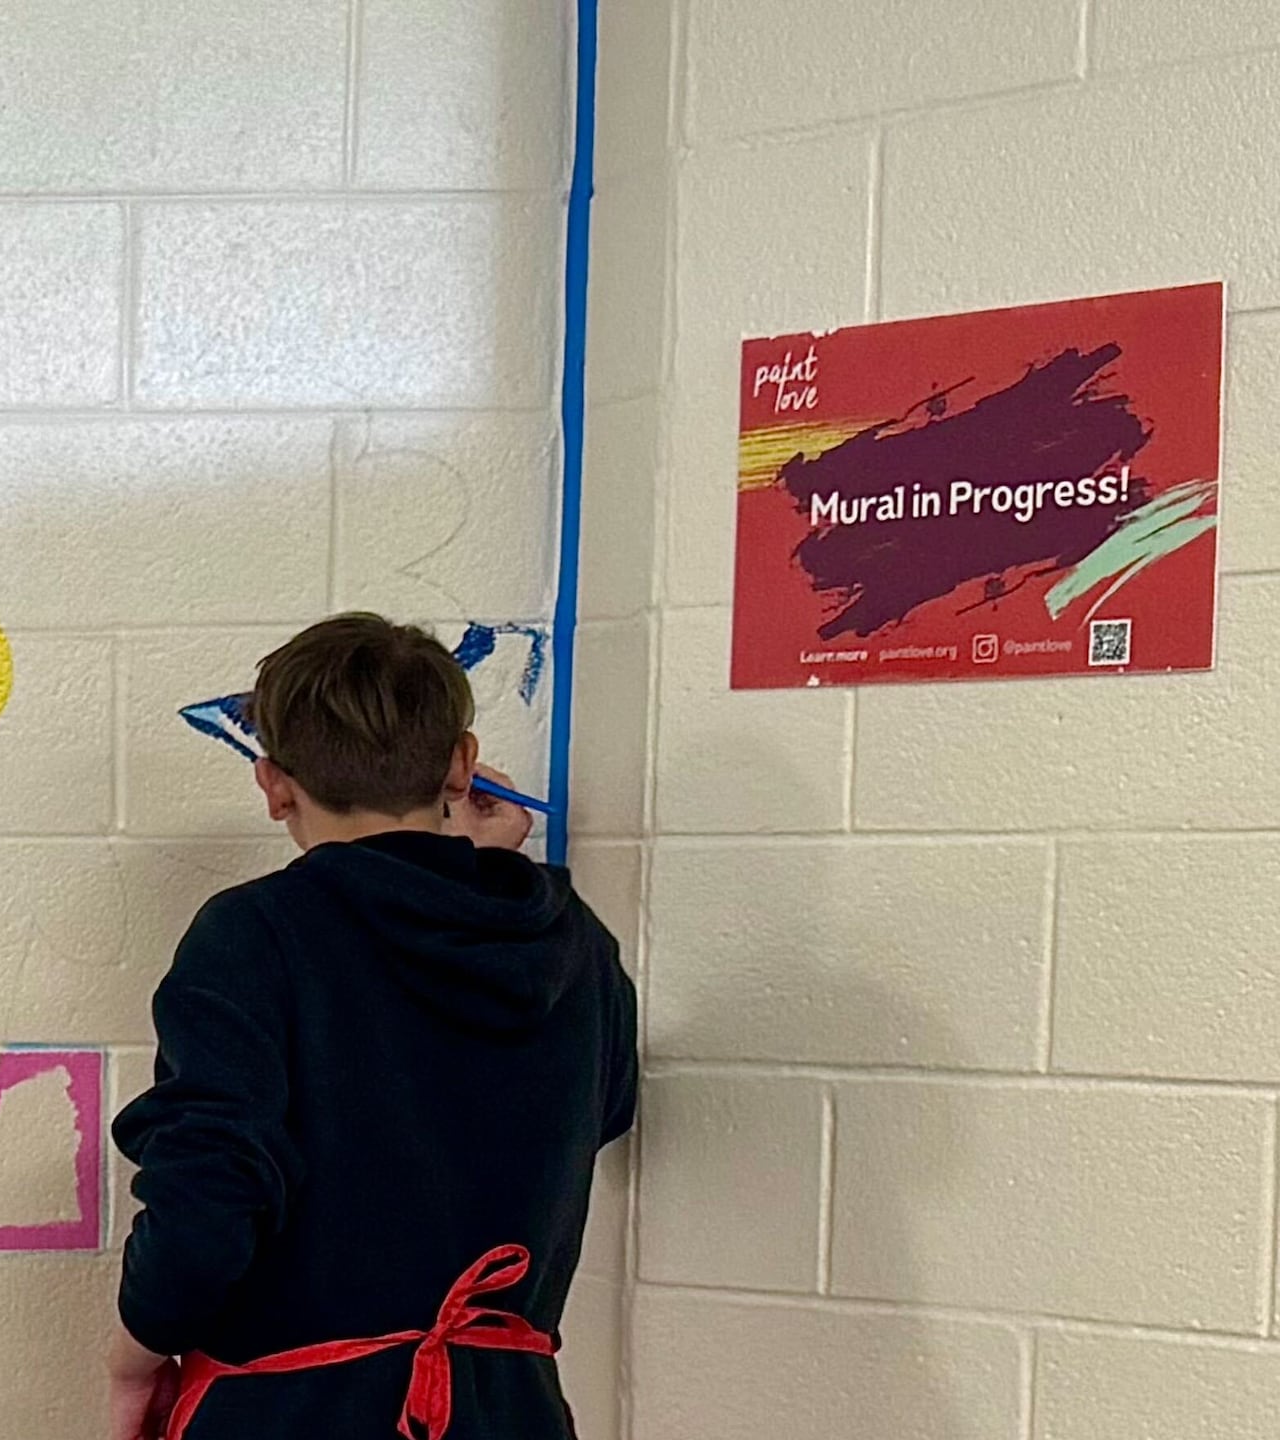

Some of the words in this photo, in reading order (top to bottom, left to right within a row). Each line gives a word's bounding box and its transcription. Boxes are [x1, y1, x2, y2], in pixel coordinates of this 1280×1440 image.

[753, 345, 818, 398] paint
[775, 381, 819, 415] love
[810, 486, 904, 526] Mural
[912, 483, 940, 518] in
[949, 465, 1130, 522] Progress!
[835, 649, 869, 662] more
